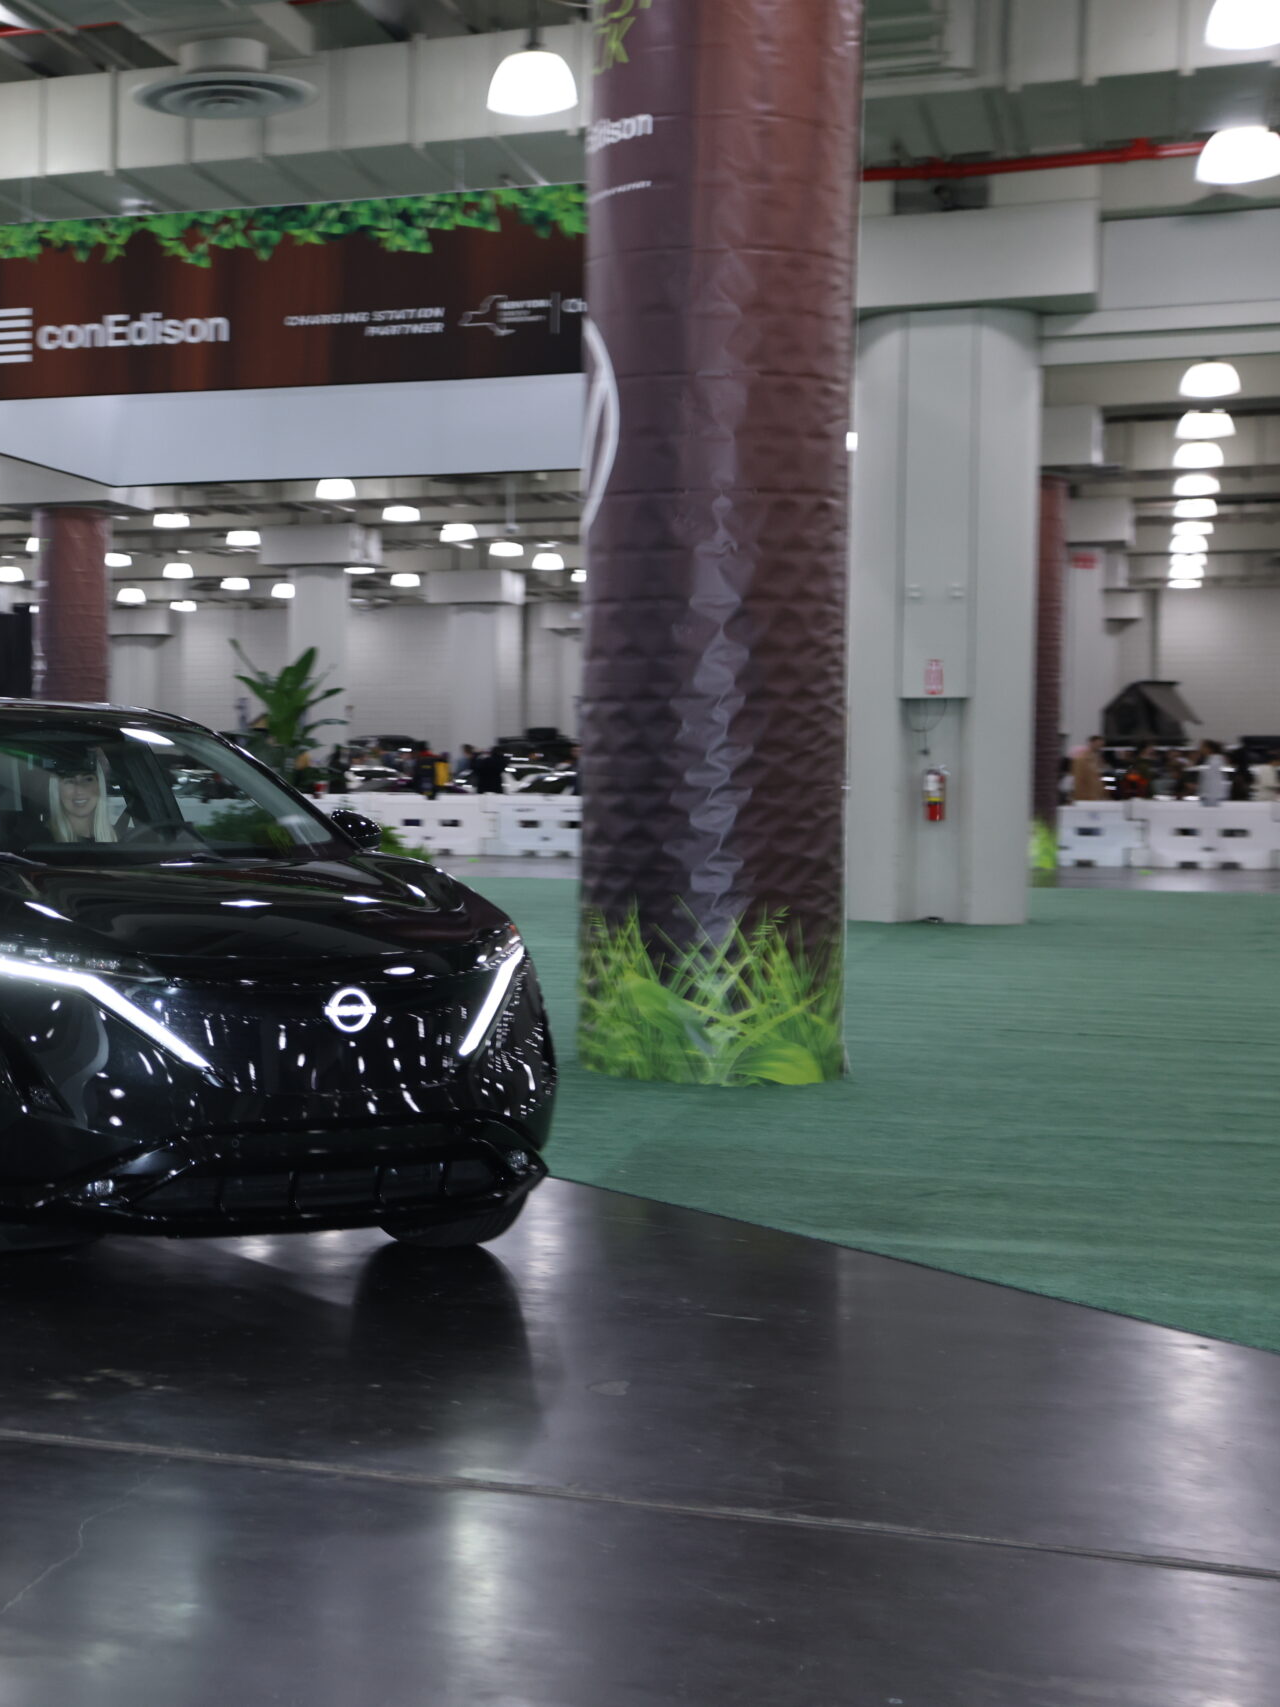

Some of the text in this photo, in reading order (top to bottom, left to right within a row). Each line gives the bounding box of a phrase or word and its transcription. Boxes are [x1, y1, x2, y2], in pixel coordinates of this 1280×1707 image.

[283, 306, 446, 327] CHARGING STATION
[35, 312, 231, 350] conEdison
[364, 322, 445, 338] PARTNER
